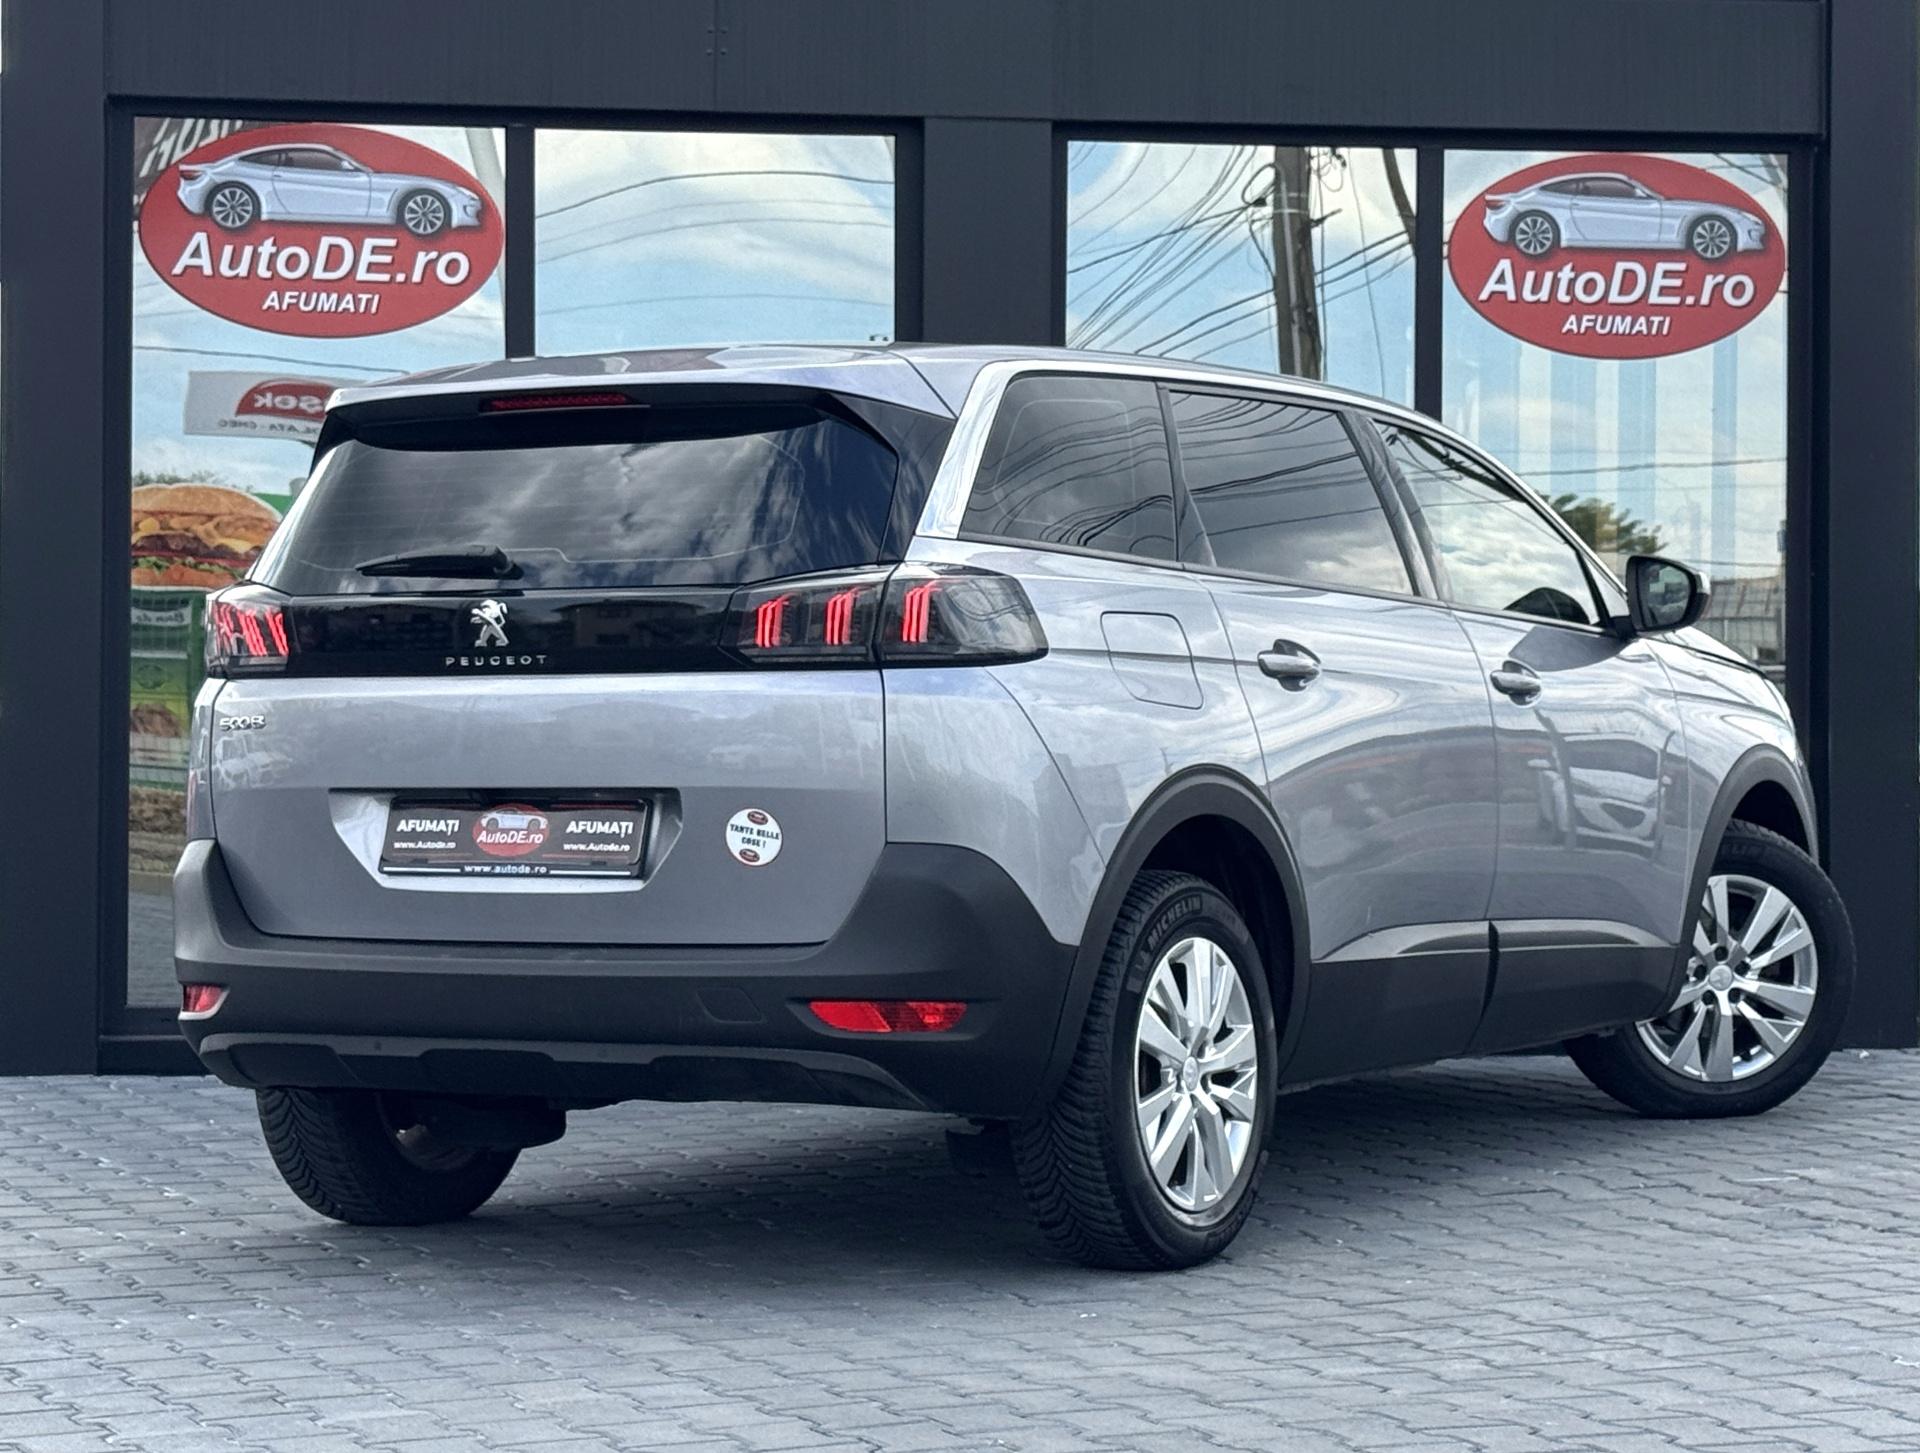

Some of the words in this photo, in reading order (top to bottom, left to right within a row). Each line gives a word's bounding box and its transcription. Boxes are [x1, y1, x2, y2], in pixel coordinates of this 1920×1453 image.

[171, 231, 470, 285] AutoDE.ro
[1478, 258, 1755, 307] AutoDE.ro
[262, 290, 381, 314] AFUMATI
[1561, 314, 1671, 336] AFUMATI
[445, 654, 547, 666] PEUGEOT
[219, 715, 266, 731] 5008
[396, 819, 460, 836] AFUMAȚI
[476, 830, 544, 843] AutoDE.ro
[565, 820, 634, 839] AFUMAȚI
[464, 864, 547, 874] www.autode.ro
[1147, 895, 1201, 950] MICHELIN
